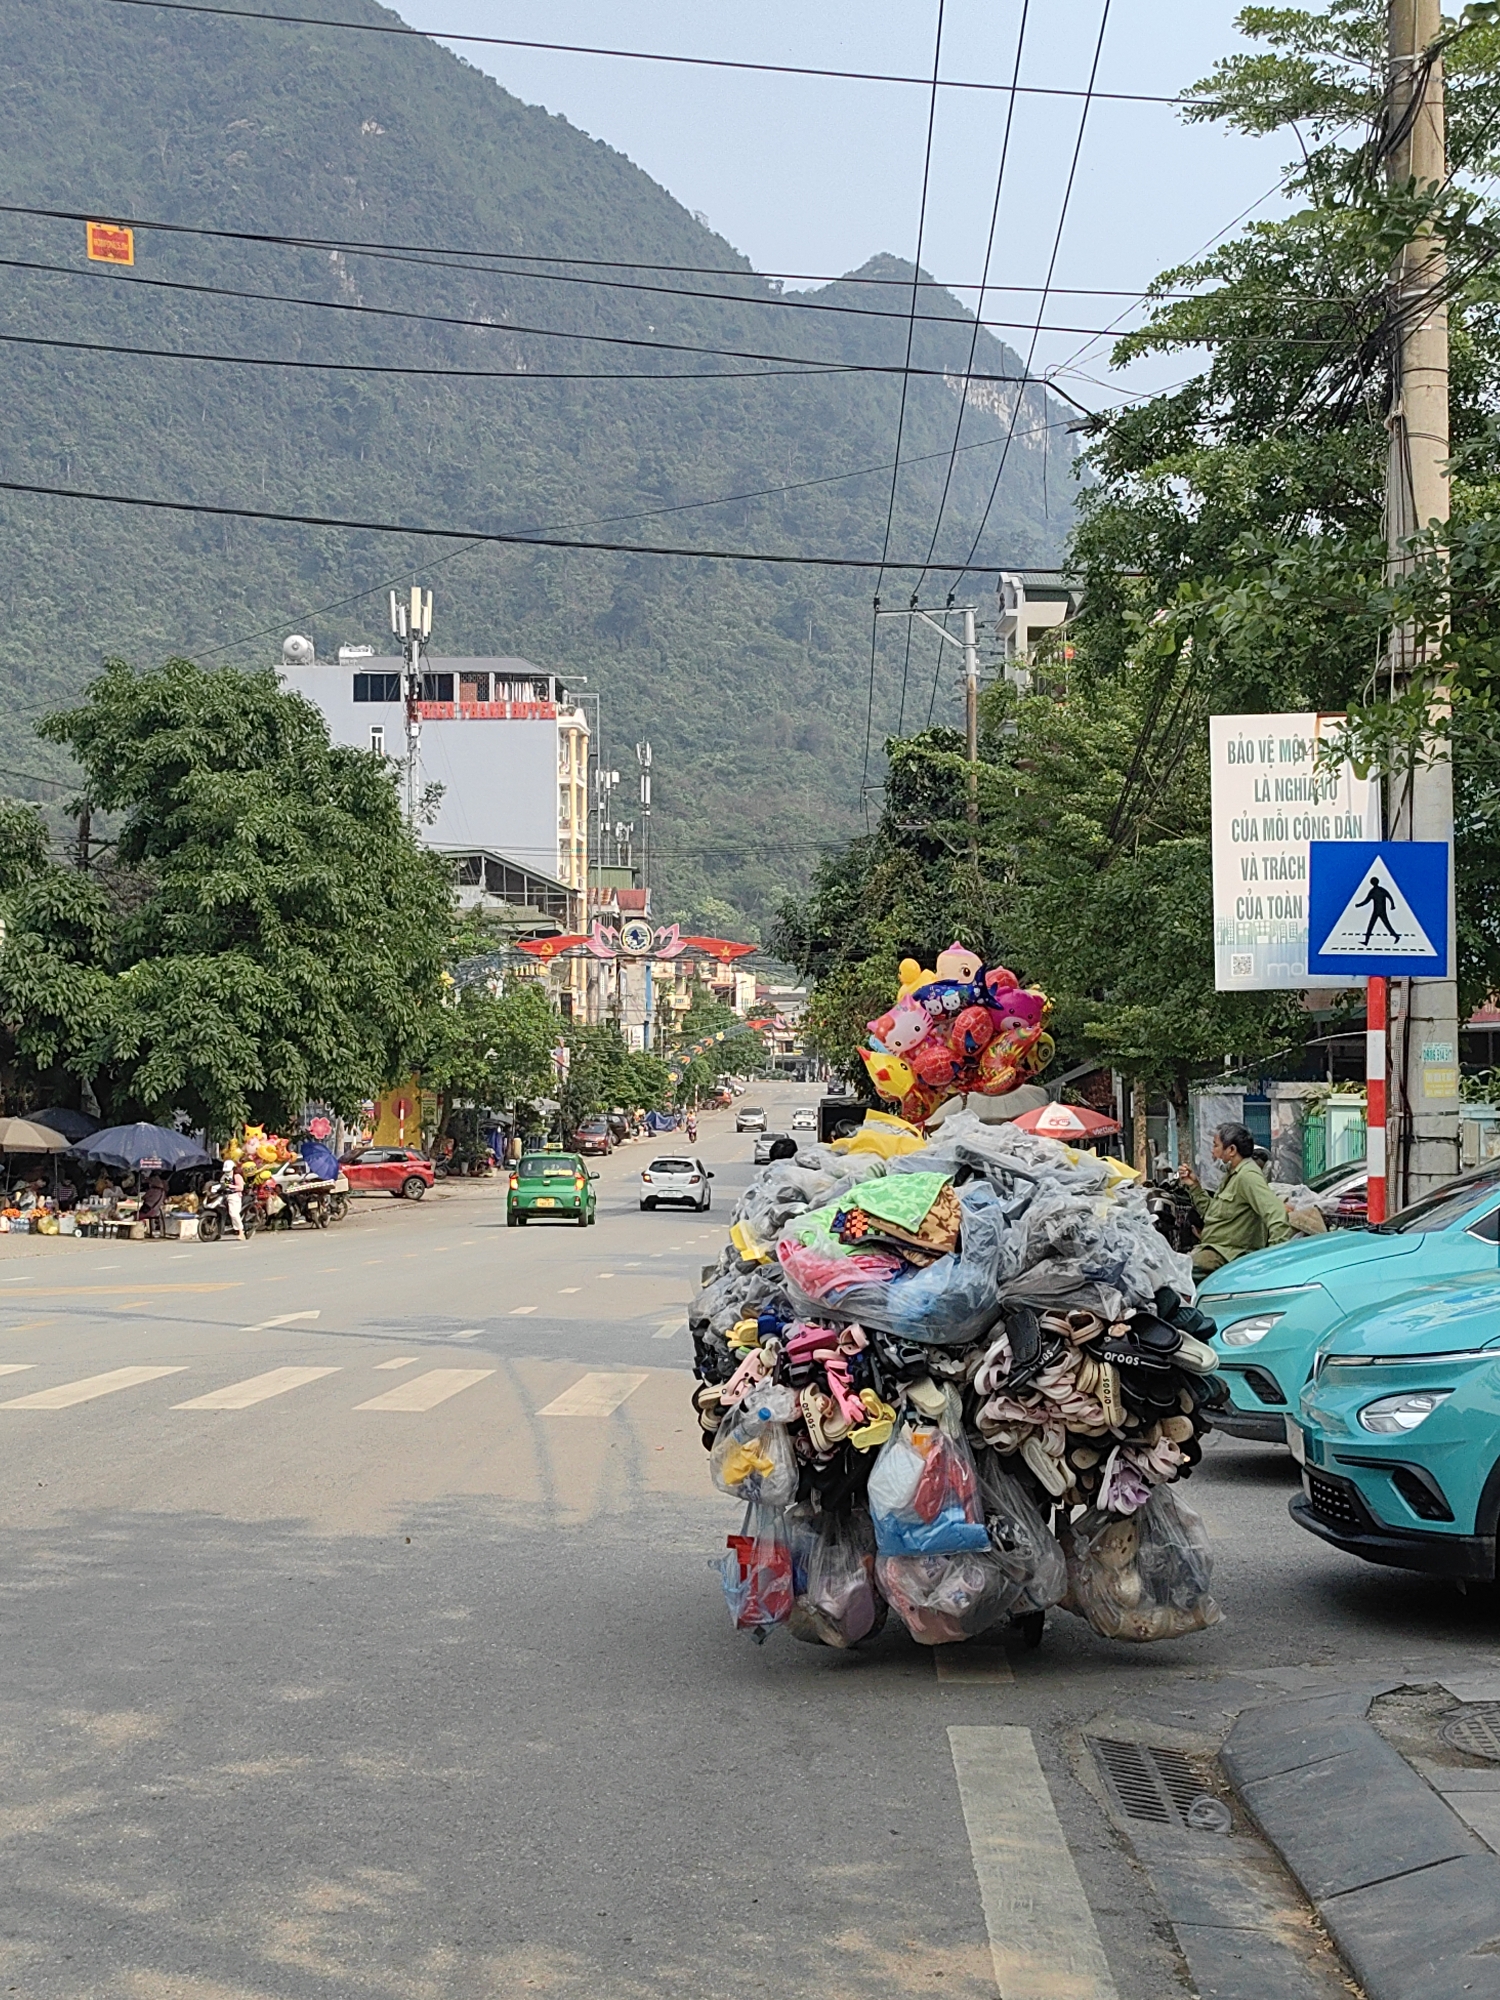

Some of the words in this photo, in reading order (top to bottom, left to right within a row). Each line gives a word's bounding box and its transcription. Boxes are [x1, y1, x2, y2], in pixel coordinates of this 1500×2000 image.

[459, 701, 506, 720] THANH
[511, 701, 557, 720] HOTEL
[1227, 732, 1254, 765] BẢO
[1258, 734, 1275, 768] VỆ
[1254, 773, 1271, 802] LÀ
[1275, 773, 1318, 802] NGHĨA
[1320, 777, 1338, 805] VỤ
[1231, 810, 1259, 842] CỦA
[1262, 809, 1289, 841] MỖI
[1293, 811, 1330, 841] CÔNG
[1334, 810, 1362, 839] DÂN
[1240, 852, 1258, 881] VÀ
[1262, 851, 1306, 880] TRÁCH
[1236, 888, 1263, 920] CỦA
[1267, 890, 1303, 919] TOÀN
